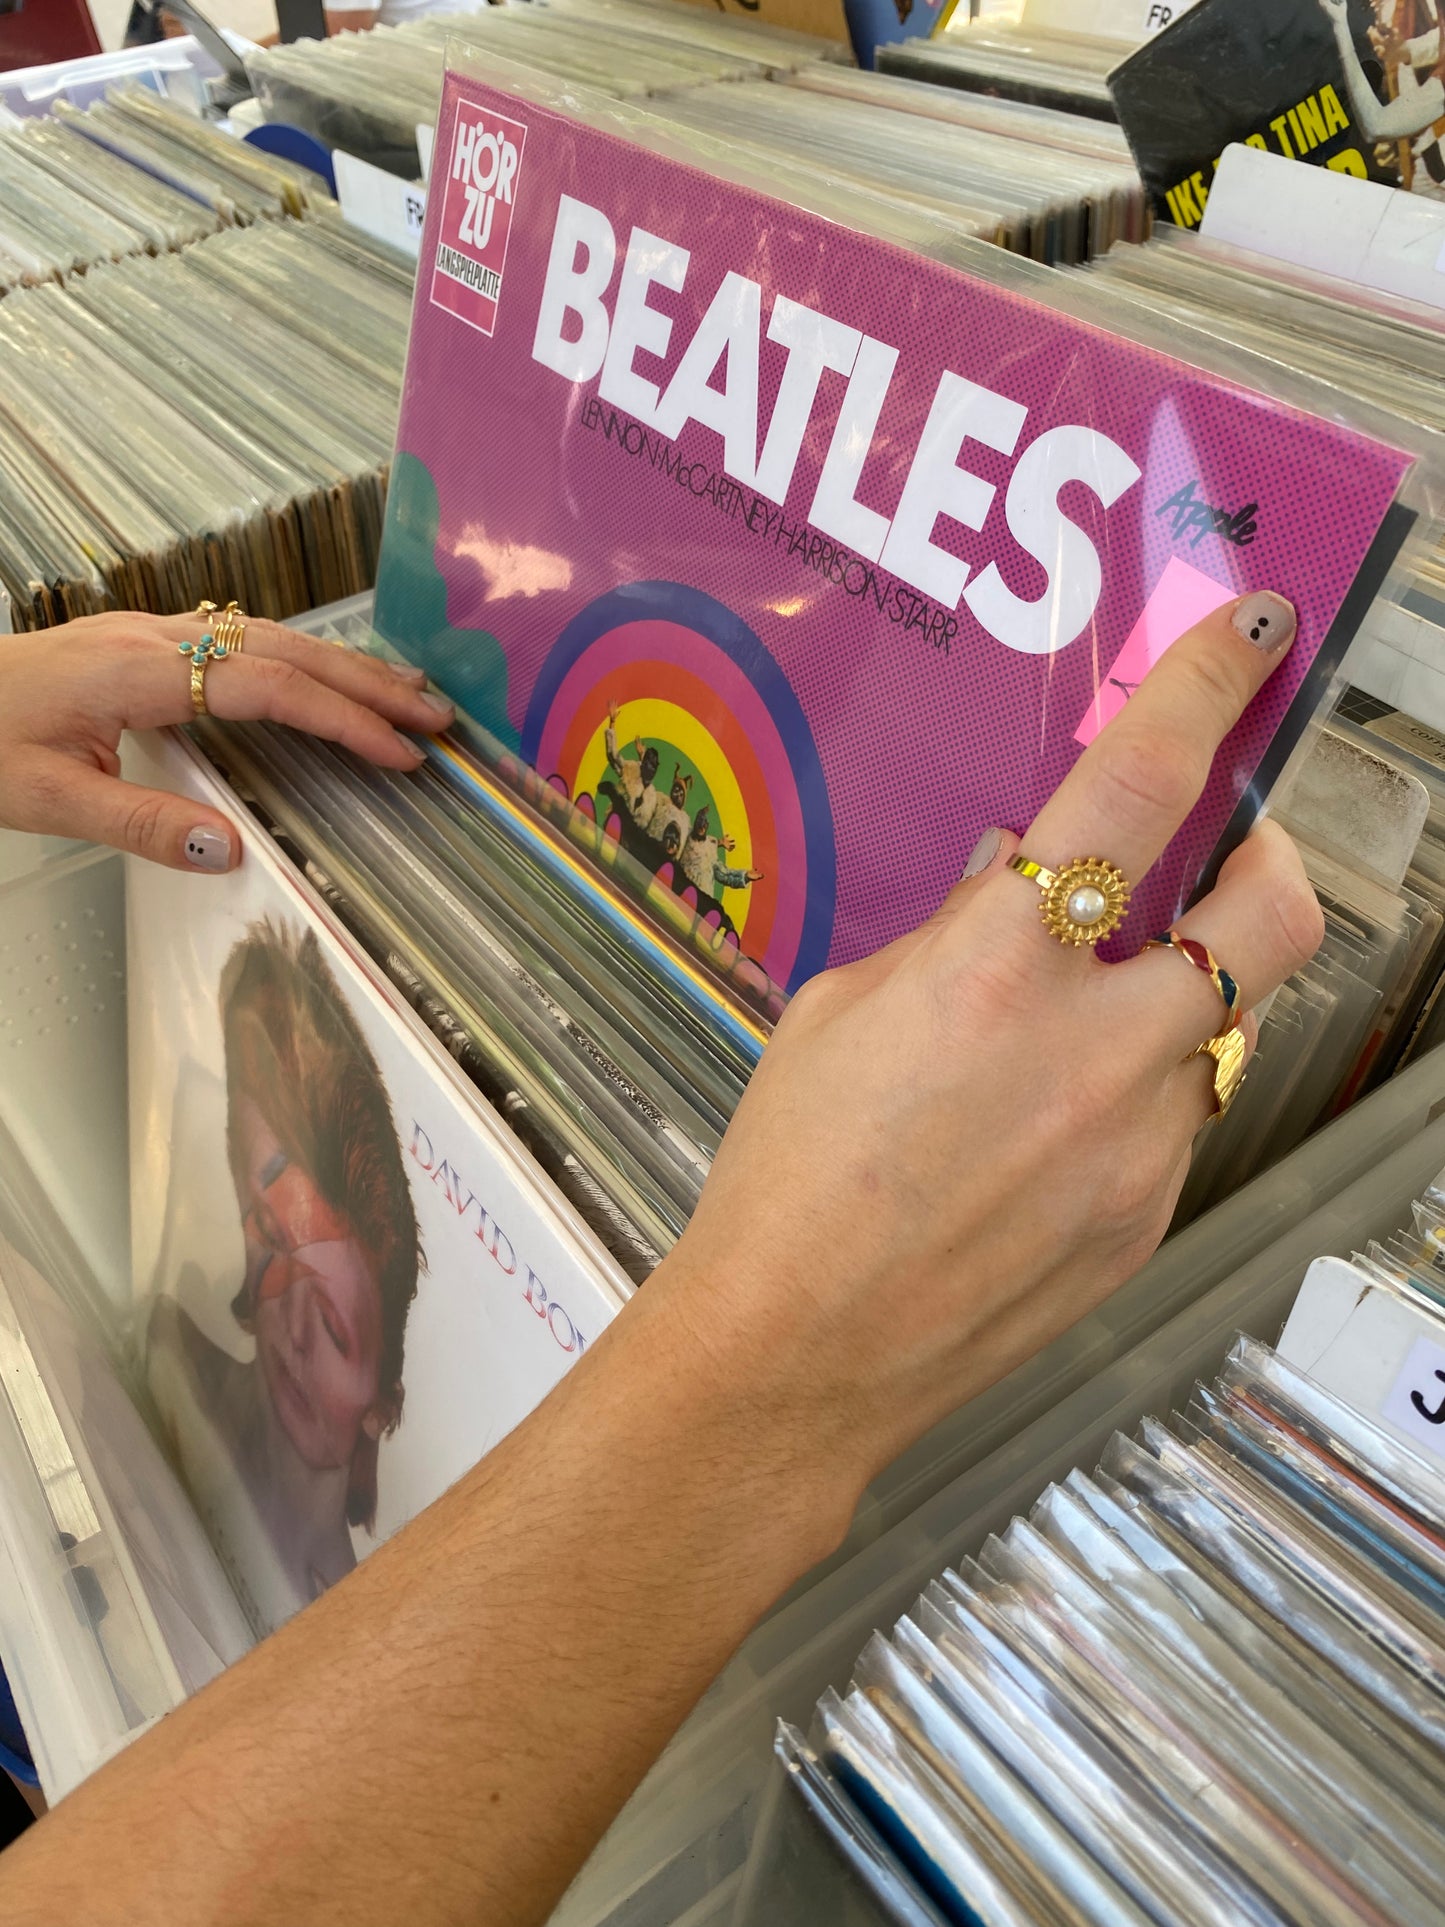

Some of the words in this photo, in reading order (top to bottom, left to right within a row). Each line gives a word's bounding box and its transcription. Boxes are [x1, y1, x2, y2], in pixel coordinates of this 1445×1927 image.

[1165, 170, 1208, 228] IKE
[1270, 84, 1350, 160] TINA
[458, 185, 496, 250] ZU
[436, 243, 501, 300] LANGSPIELPLATTE
[532, 194, 1143, 654] BEATLES
[1155, 479, 1260, 549] Apple
[409, 1118, 518, 1276] DAVID
